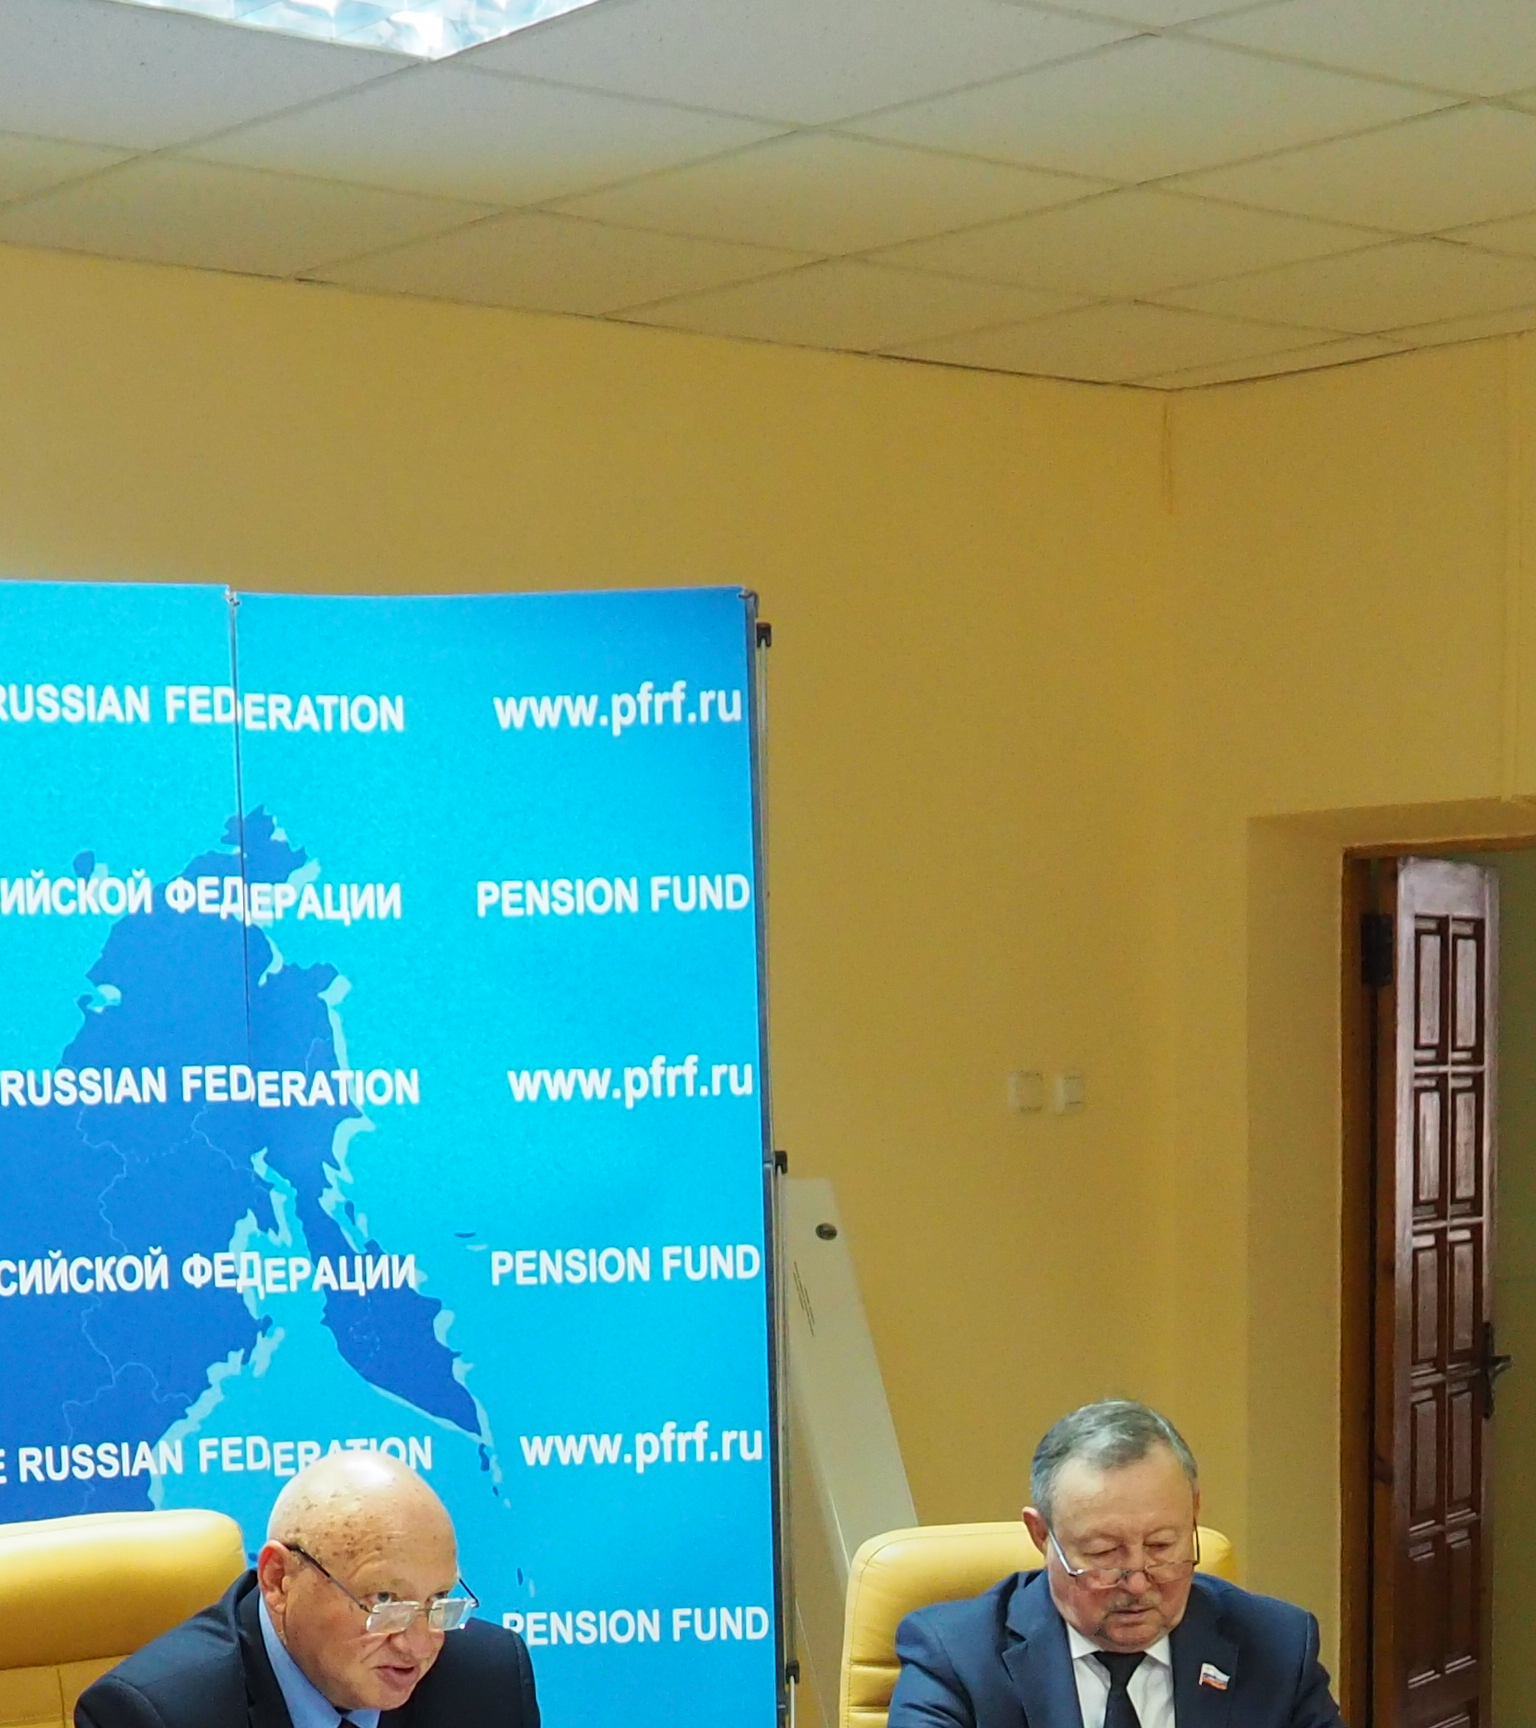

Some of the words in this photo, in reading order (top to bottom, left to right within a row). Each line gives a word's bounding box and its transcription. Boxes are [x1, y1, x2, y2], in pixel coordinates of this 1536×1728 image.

[165, 685, 405, 732] FEDERATION
[493, 681, 742, 736] www.pfrf.ru
[165, 874, 402, 927] ФЕДЕРАЦИИ
[476, 877, 638, 918] PENSION
[651, 874, 751, 912] FUND
[0, 1066, 166, 1107] RUSSIAN
[181, 1064, 420, 1108] FEDERATION
[507, 1055, 753, 1109] www.pfrf.ru
[182, 1250, 417, 1298] ФЕДЕРАЦИИ
[491, 1247, 651, 1285] PENSION
[663, 1244, 761, 1280] FUND
[19, 1438, 184, 1483] RUSSIAN
[521, 1421, 763, 1473] www.pfrf.ru
[503, 1609, 660, 1646] PENSION
[673, 1607, 769, 1642] FUND
